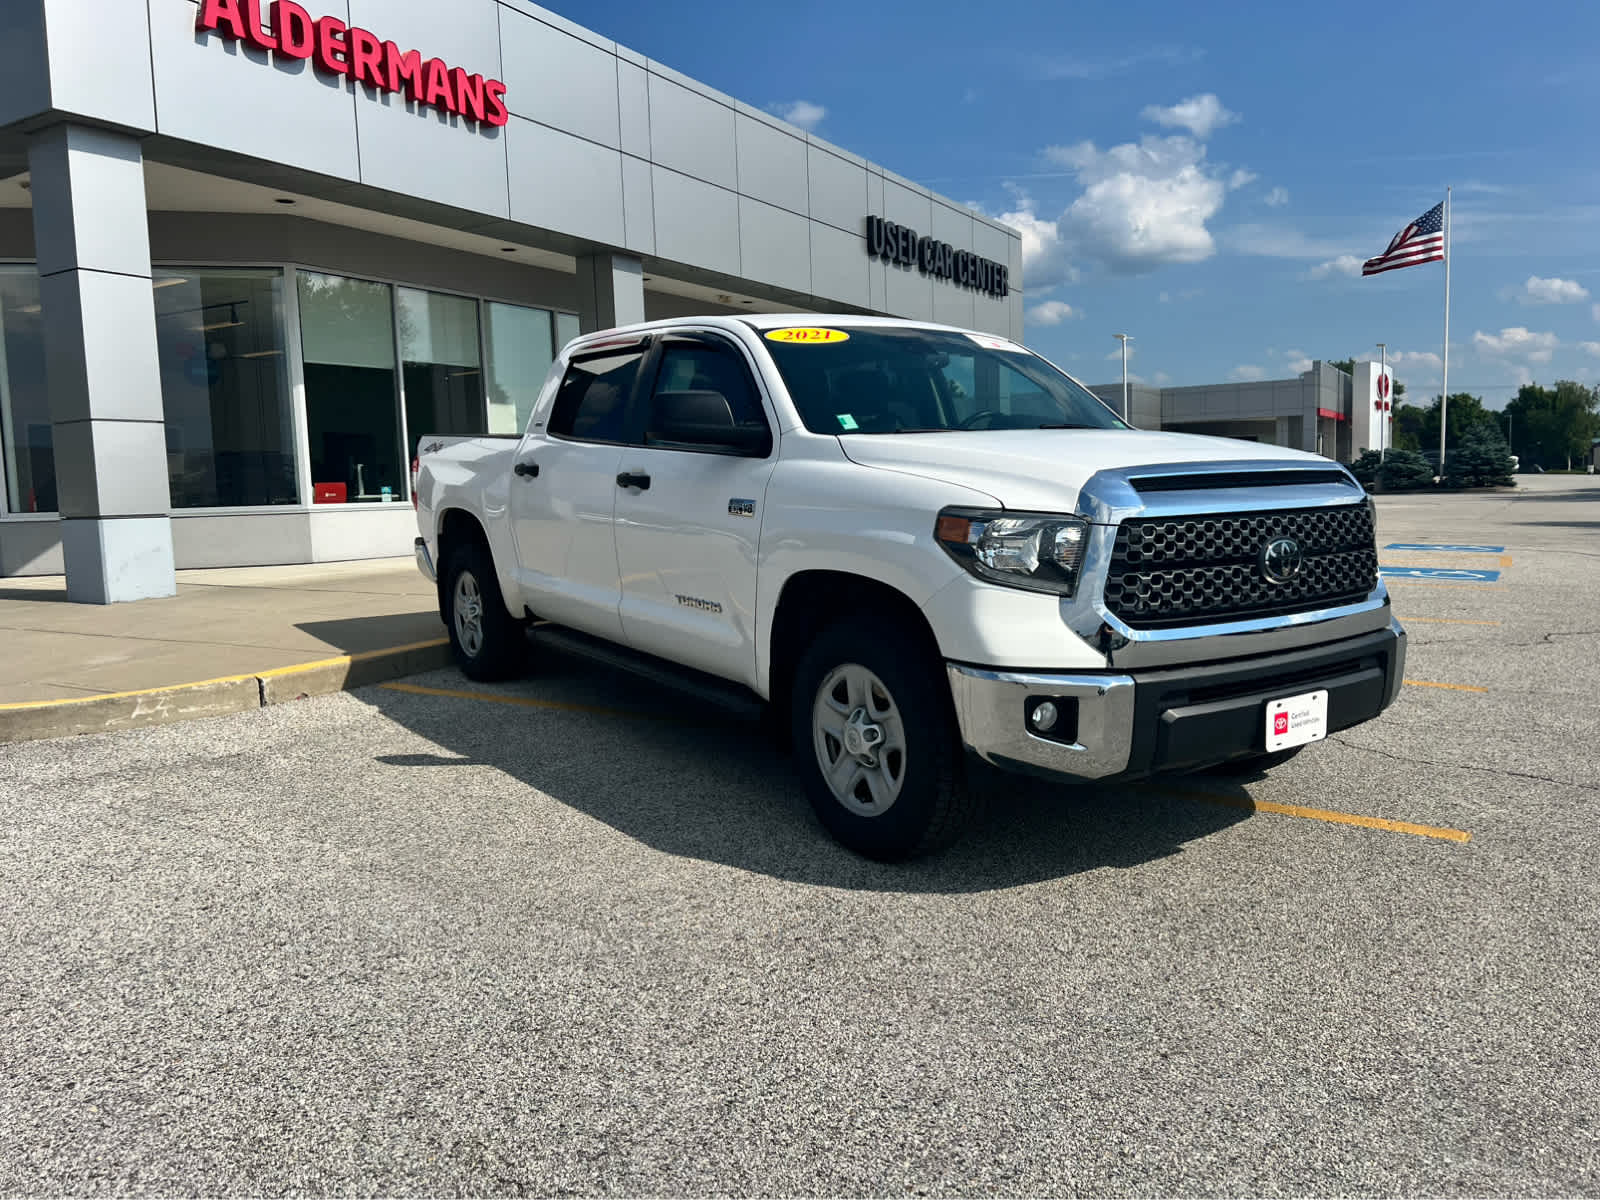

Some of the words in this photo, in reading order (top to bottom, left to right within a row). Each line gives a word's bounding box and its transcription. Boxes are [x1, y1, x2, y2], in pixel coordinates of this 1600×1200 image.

[196, 0, 508, 128] ALDERMANS
[867, 215, 918, 265] USED
[919, 236, 954, 279] CAR
[953, 249, 1009, 297] CENTER
[784, 330, 831, 340] 2021
